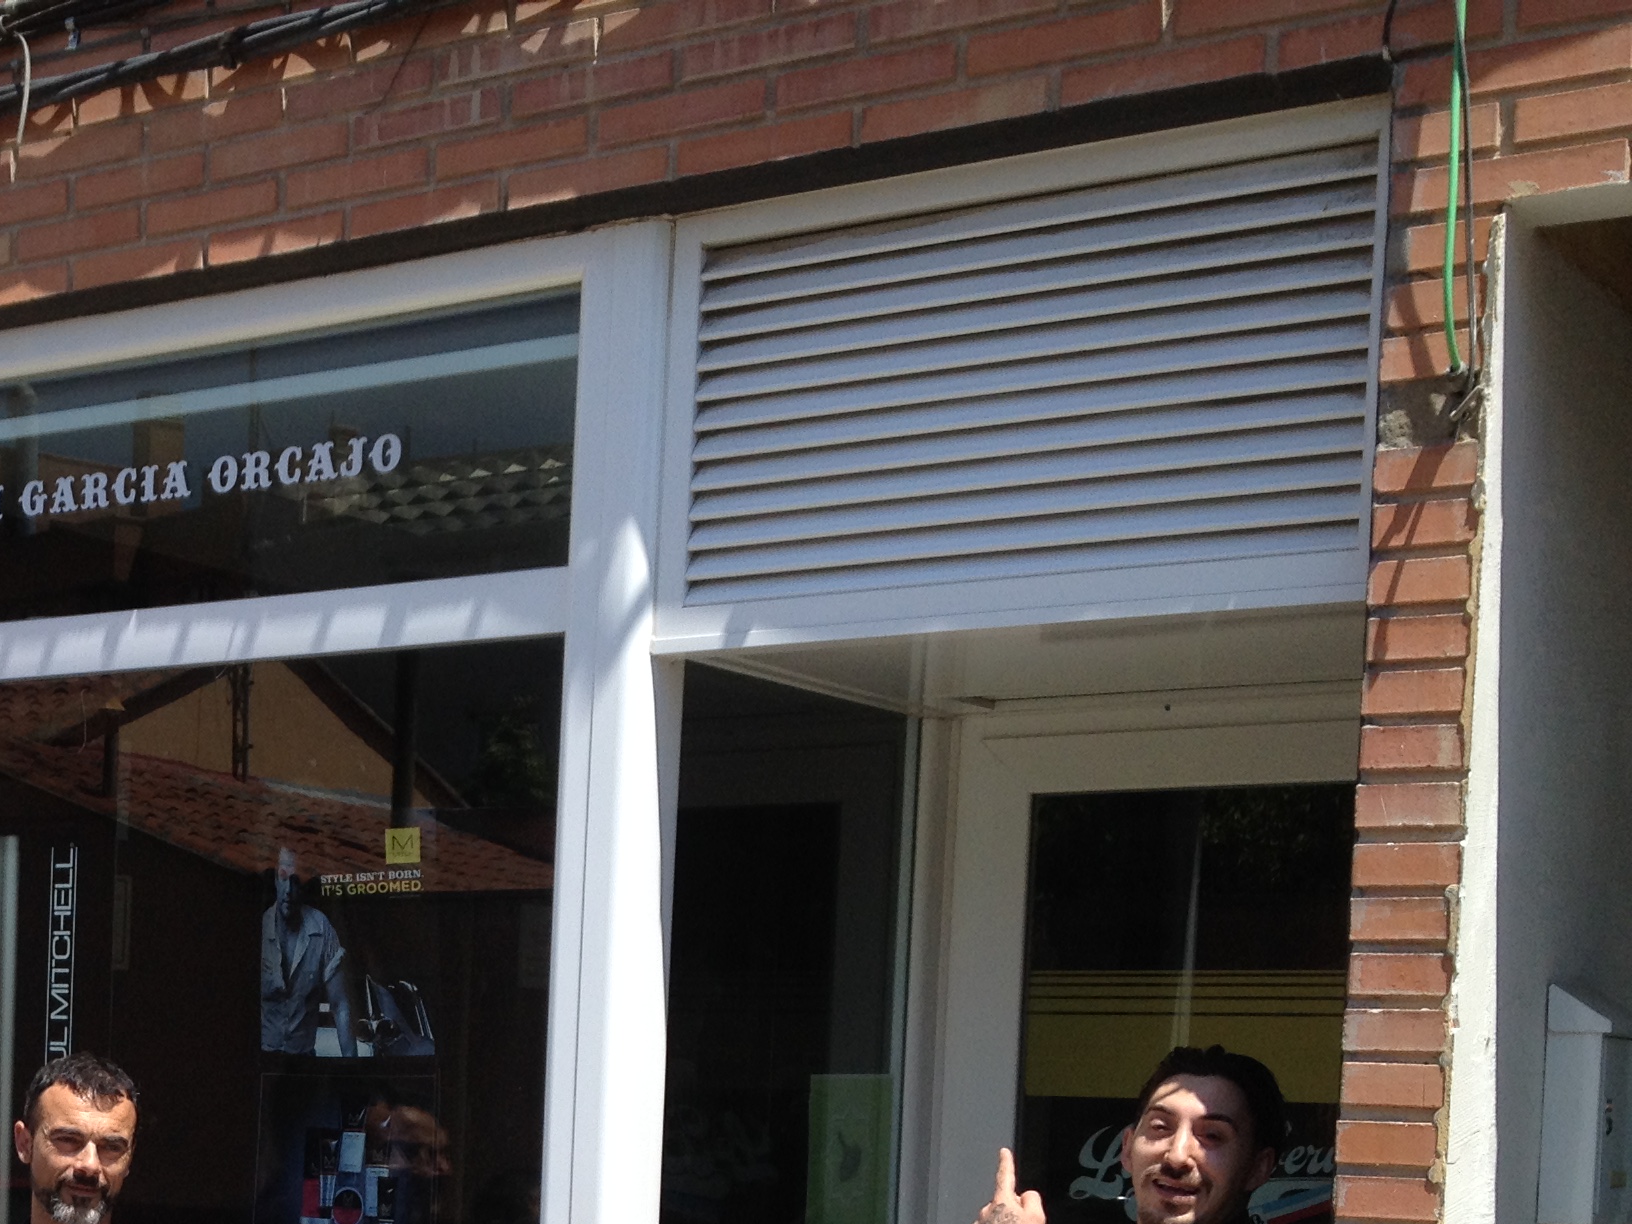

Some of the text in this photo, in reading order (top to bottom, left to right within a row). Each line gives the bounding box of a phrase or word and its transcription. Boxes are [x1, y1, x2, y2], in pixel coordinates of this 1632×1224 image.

[19, 461, 192, 519] GARCIA
[207, 433, 403, 494] ORCAJO
[320, 869, 424, 884] STYLE ISN'T BORN.
[321, 880, 424, 896] IT'S GROOMED.
[50, 846, 74, 1020] MITCHELL
